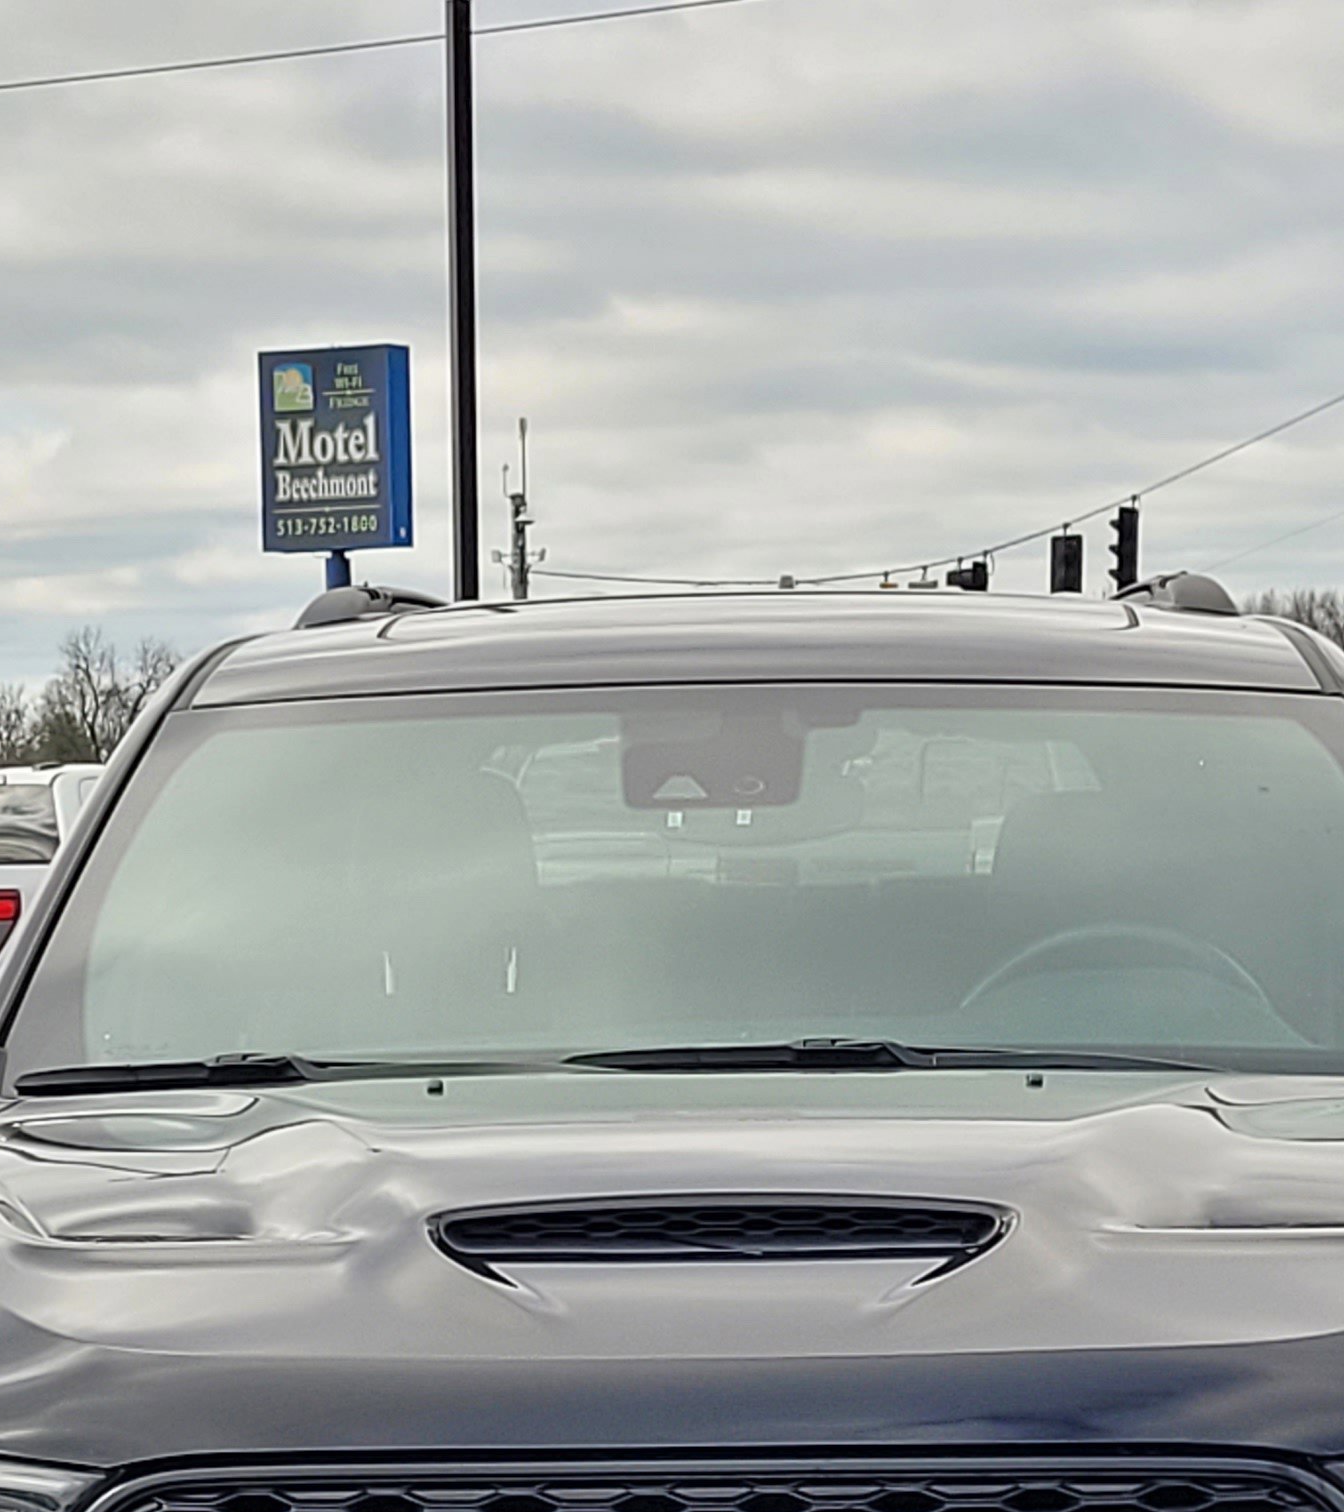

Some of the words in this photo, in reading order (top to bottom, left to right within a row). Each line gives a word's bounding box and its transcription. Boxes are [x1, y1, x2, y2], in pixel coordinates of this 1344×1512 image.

[273, 412, 380, 466] Motel
[274, 468, 378, 502] Beechmont
[276, 514, 378, 537] 513-752-1800
